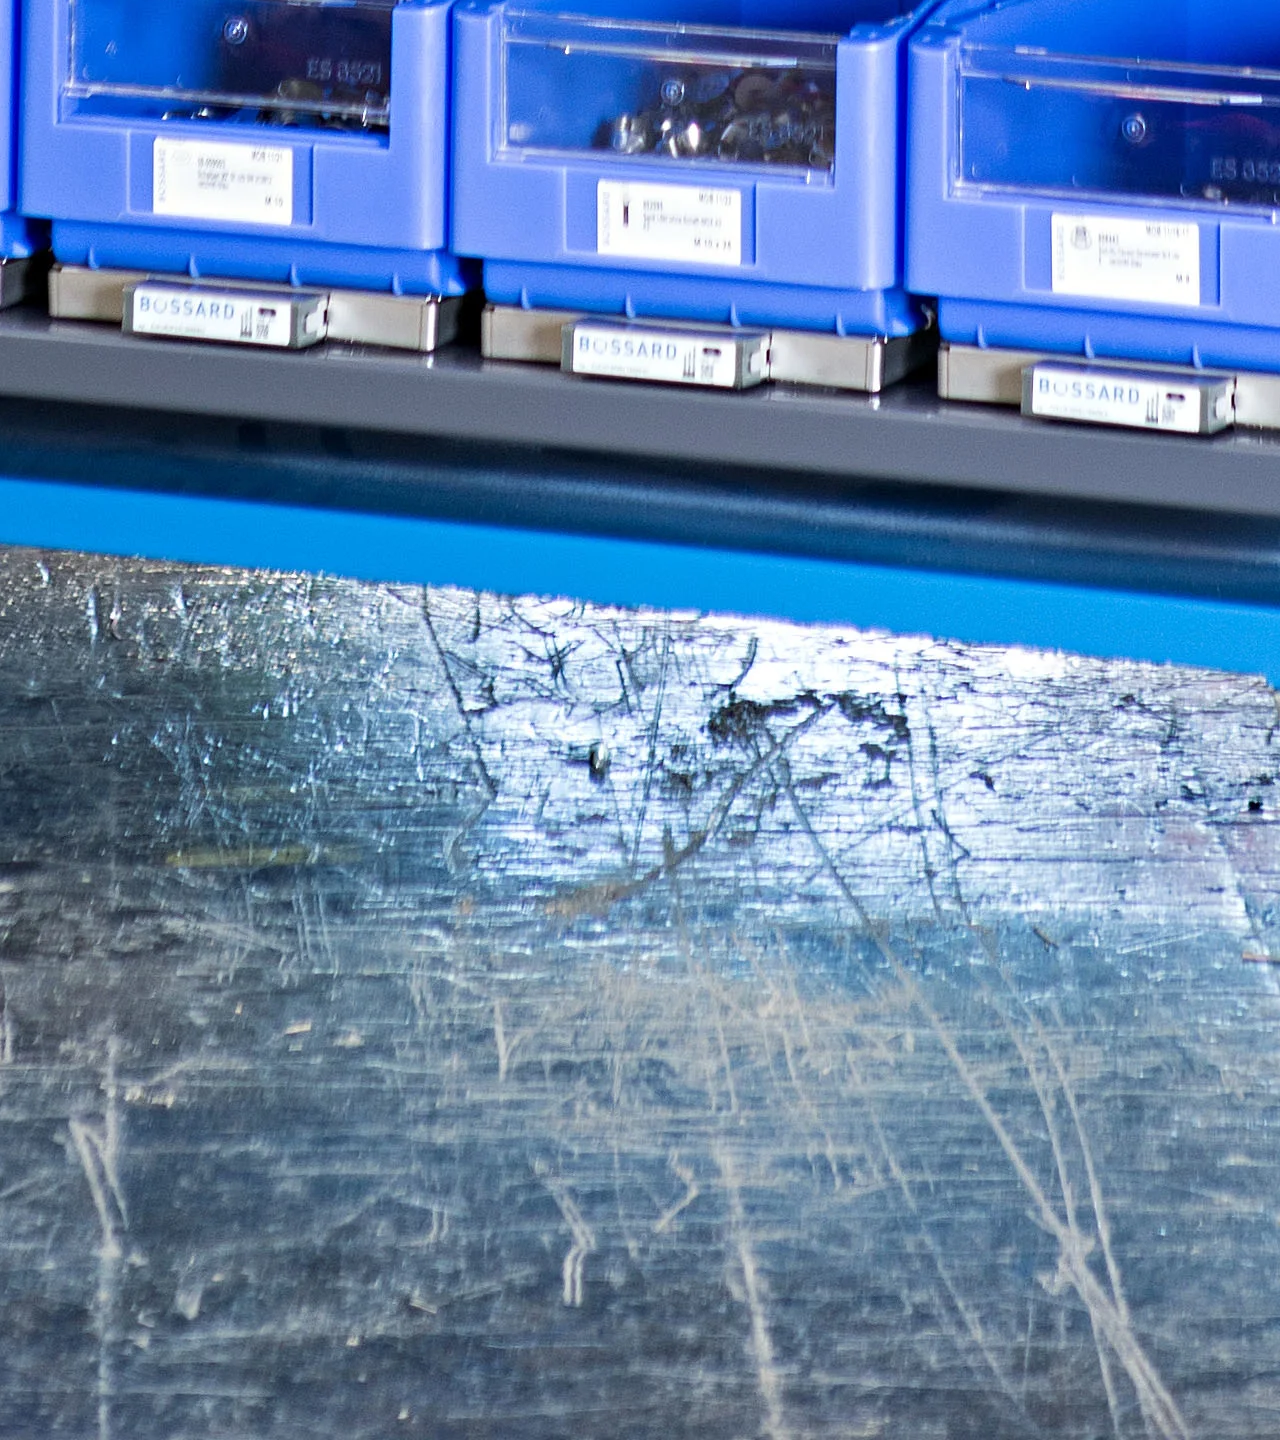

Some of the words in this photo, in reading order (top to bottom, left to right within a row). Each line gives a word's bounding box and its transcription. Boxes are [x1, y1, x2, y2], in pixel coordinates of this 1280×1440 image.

[140, 294, 236, 319] BOSSARD
[579, 334, 678, 359] BOSSARD
[1039, 377, 1141, 403] BOSSARD
